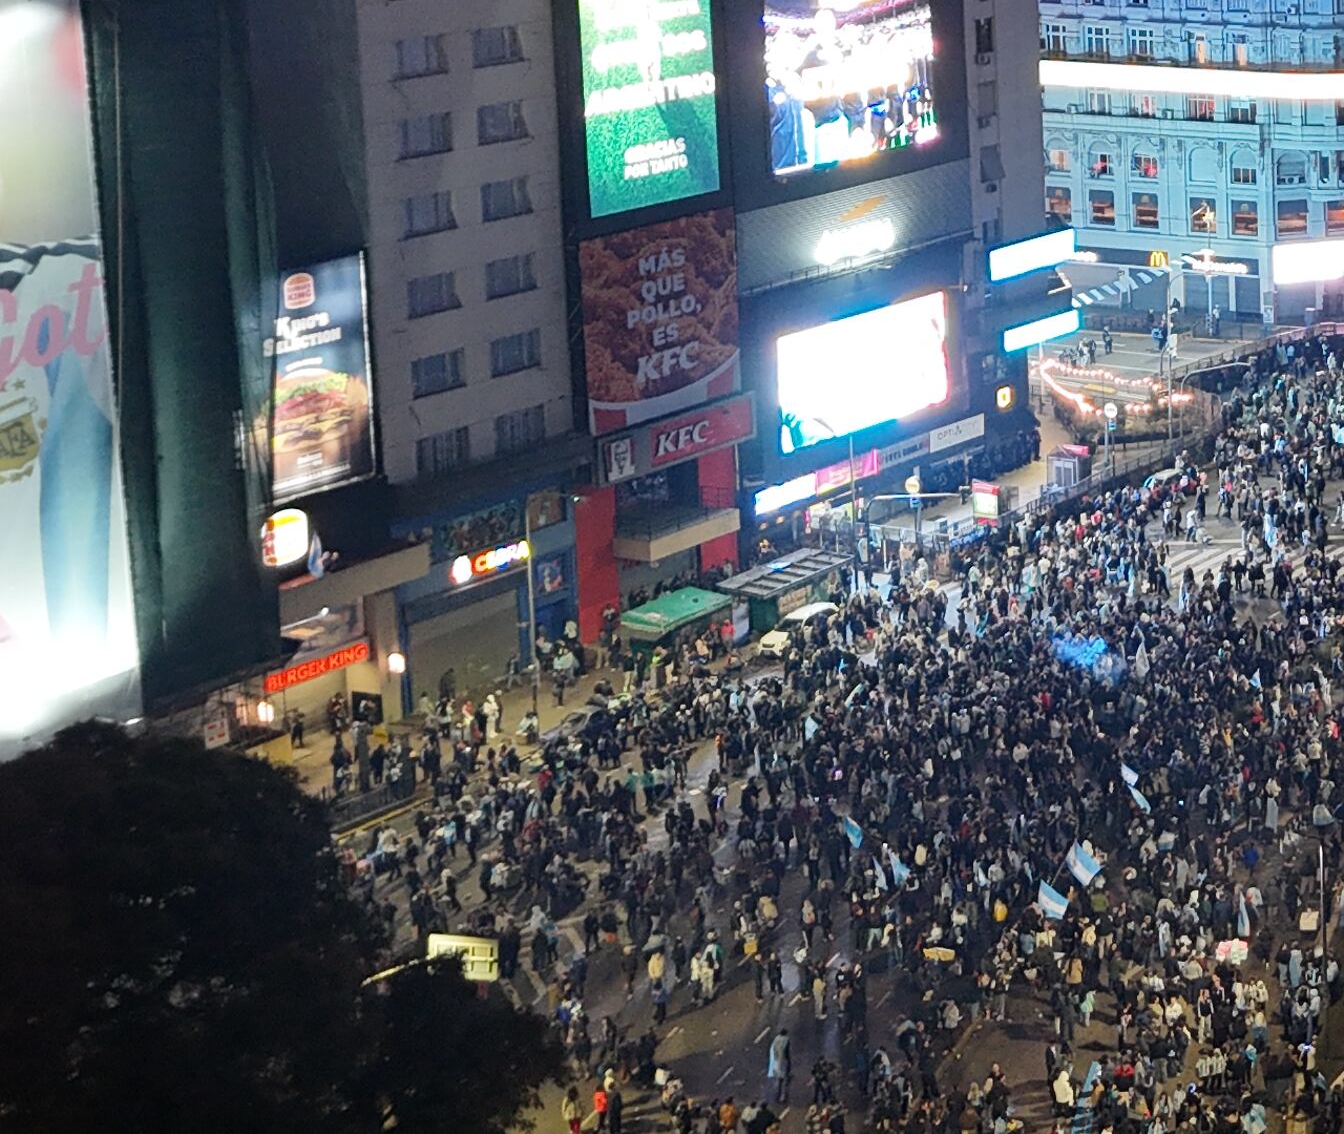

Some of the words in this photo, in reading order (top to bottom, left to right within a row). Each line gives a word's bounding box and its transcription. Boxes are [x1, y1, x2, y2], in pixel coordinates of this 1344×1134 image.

[650, 153, 689, 176] TANTO
[638, 246, 686, 276] MÁS
[641, 273, 685, 303] QUE
[627, 294, 702, 330] POLLO,
[652, 323, 679, 347] ES
[635, 340, 701, 389] KFC
[655, 420, 710, 458] KFC
[265, 662, 326, 692] BURGER
[329, 642, 369, 669] KING
